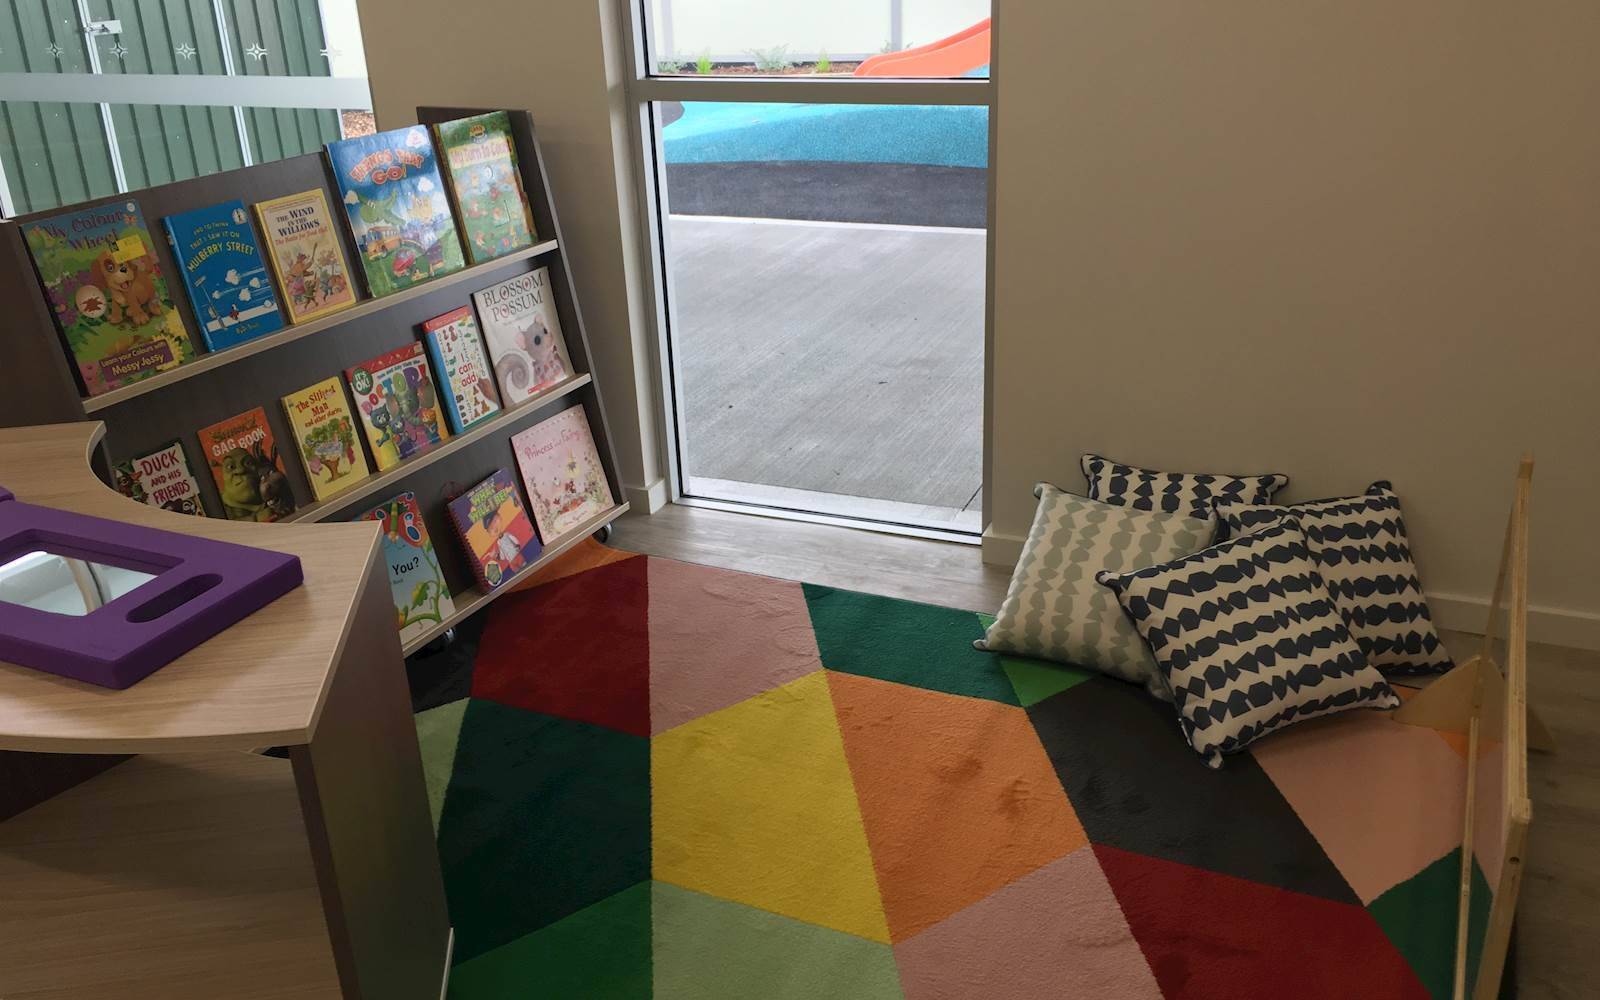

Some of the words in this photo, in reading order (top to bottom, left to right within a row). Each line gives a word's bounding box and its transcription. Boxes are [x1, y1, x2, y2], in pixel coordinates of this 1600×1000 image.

[371, 163, 407, 185] GO!
[72, 209, 122, 232] Colour
[289, 206, 314, 219] WIND
[230, 230, 240, 239] ON
[278, 220, 320, 237] WILLOWS
[187, 241, 223, 272] MULBERRY
[226, 241, 254, 255] STREET
[482, 271, 544, 307] BLOSSOM
[492, 290, 543, 322] POSSUM
[458, 362, 474, 375] can
[355, 378, 371, 391] OK!
[461, 373, 477, 388] add
[295, 400, 310, 414] The
[311, 402, 329, 417] Man
[304, 419, 314, 428] and
[314, 413, 327, 424] other
[327, 407, 343, 418] stories
[211, 438, 237, 457] GAG
[237, 425, 267, 449] BOOK
[524, 440, 554, 460] Princess
[141, 449, 180, 476] DUCK
[151, 475, 167, 487] AND
[167, 468, 182, 481] HIS
[153, 479, 191, 504] FRIENDS
[392, 556, 419, 576] You?
